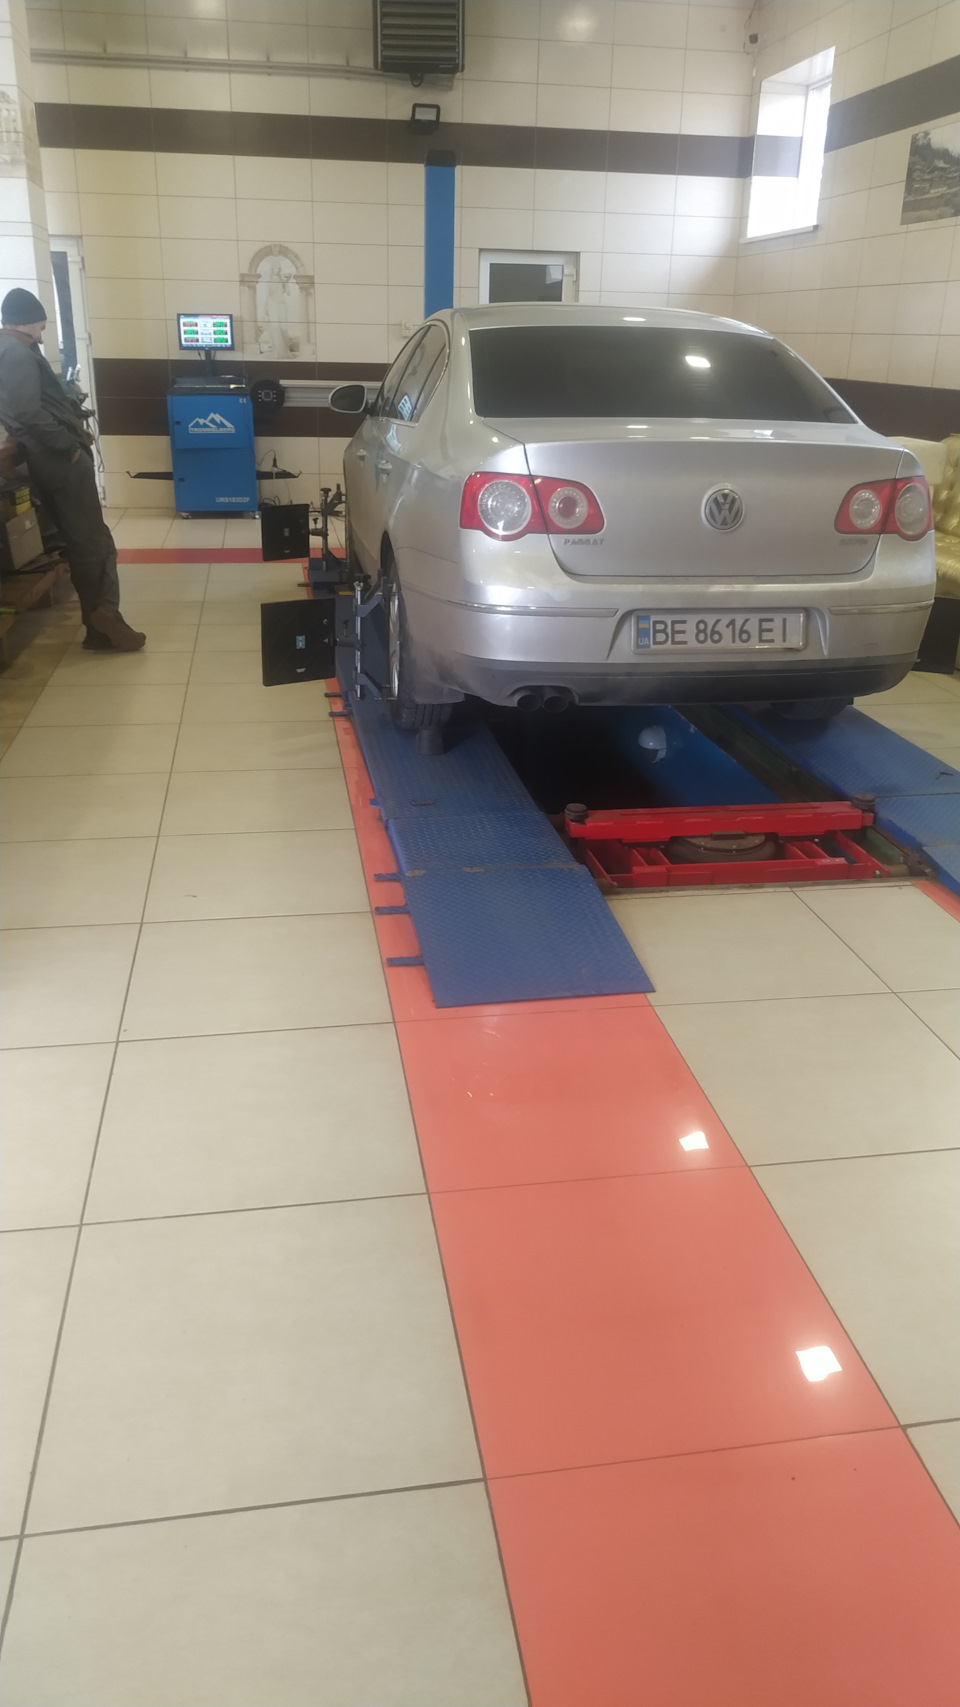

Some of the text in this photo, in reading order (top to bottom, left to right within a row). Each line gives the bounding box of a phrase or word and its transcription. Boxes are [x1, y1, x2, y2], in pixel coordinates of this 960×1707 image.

[652, 617, 787, 646] BE 8616 EI
[638, 637, 650, 646] UA
